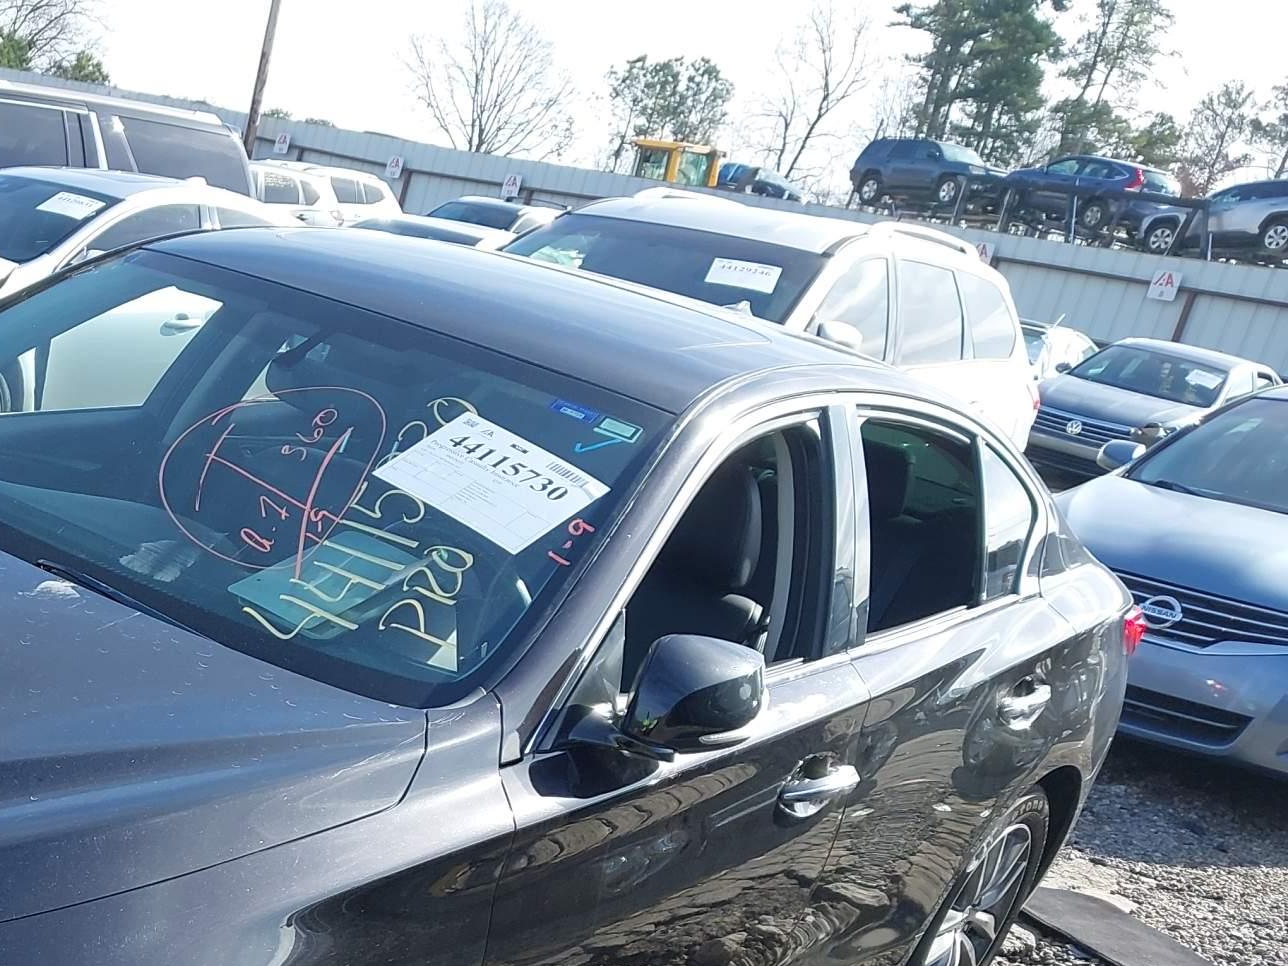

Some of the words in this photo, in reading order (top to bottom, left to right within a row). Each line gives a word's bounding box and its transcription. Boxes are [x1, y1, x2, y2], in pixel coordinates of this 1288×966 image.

[449, 436, 569, 501] 44115730
[242, 396, 479, 640] 441150
[1142, 605, 1178, 619] NISSAN
